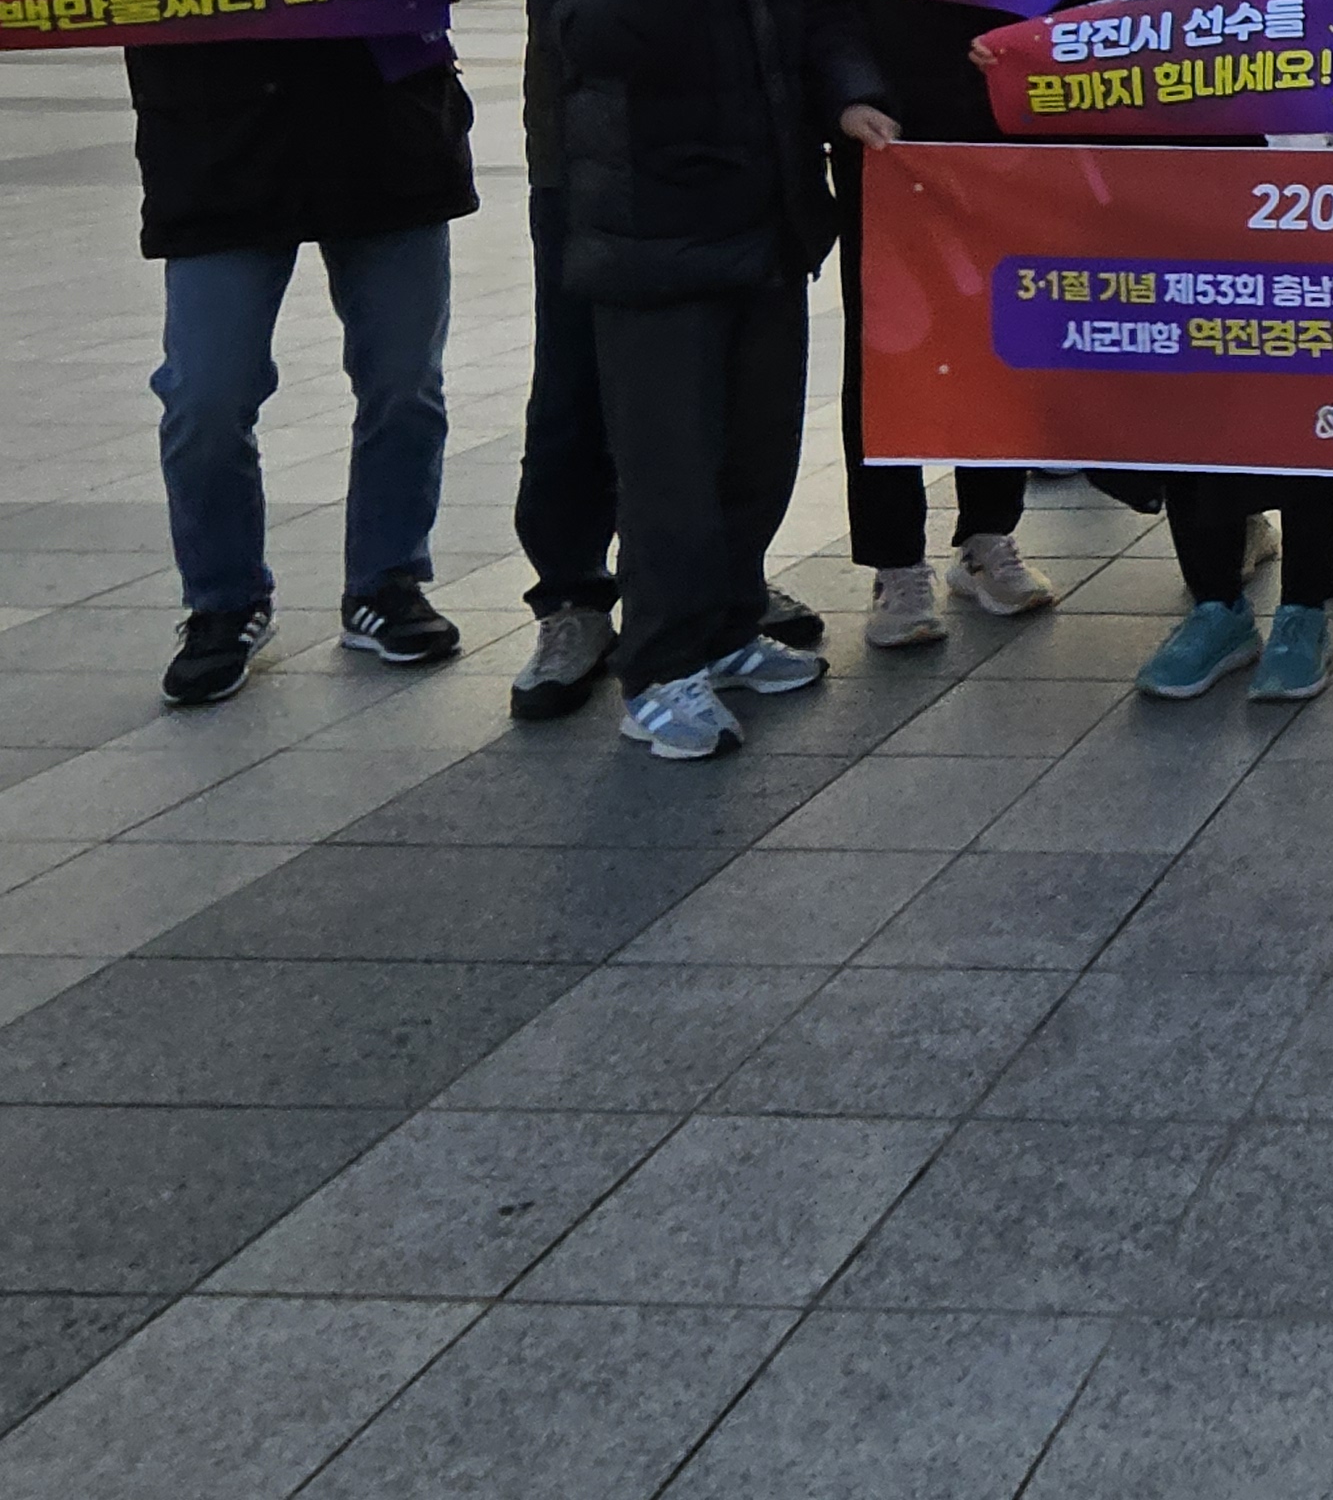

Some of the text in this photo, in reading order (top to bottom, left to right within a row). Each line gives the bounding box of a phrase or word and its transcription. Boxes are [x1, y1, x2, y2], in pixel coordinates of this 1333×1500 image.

[1050, 10, 1173, 63] 당진시
[1026, 48, 1333, 115] 끝까지 힘내세요!
[1097, 271, 1157, 304] 기념
[1164, 273, 1264, 306] 제53회
[1062, 320, 1182, 354] 시군대항
